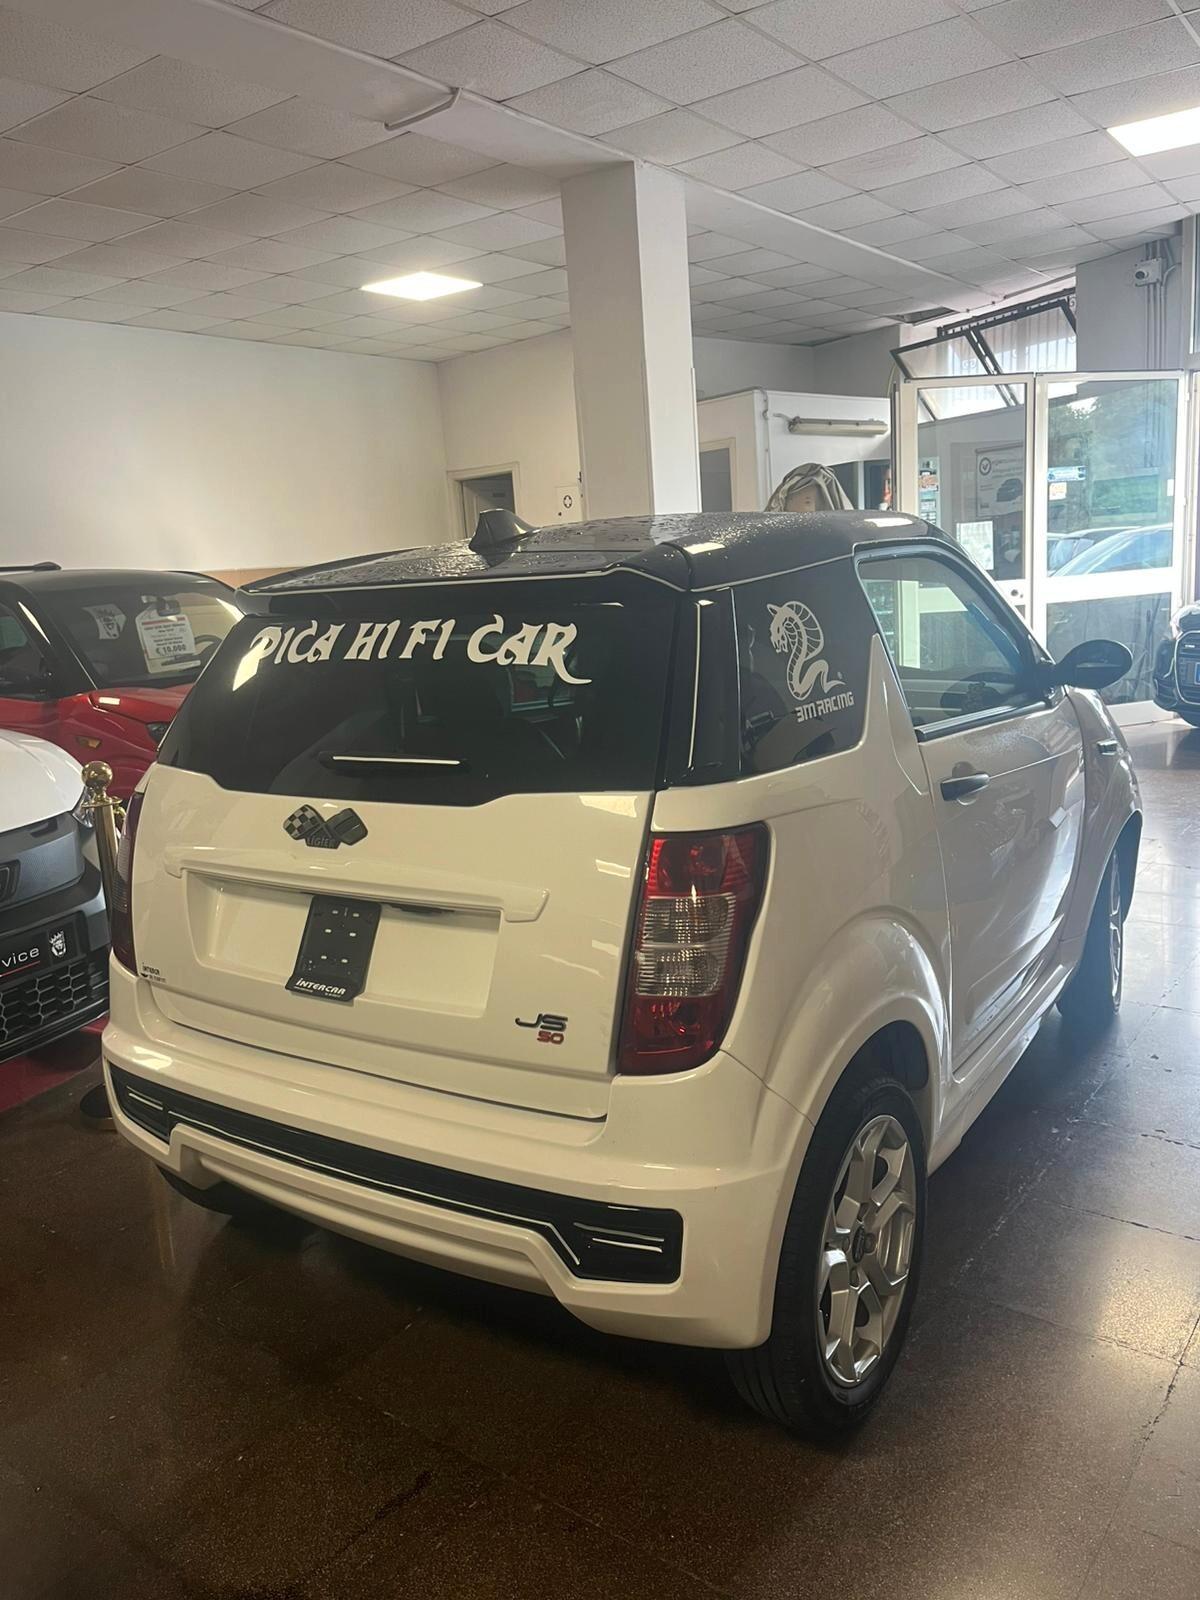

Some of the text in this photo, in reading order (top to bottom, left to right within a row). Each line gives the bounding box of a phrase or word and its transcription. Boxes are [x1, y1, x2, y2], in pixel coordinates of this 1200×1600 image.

[232, 619, 346, 691] PICA
[466, 614, 593, 685] CAR
[816, 692, 854, 715] RACING
[515, 1013, 568, 1032] JS
